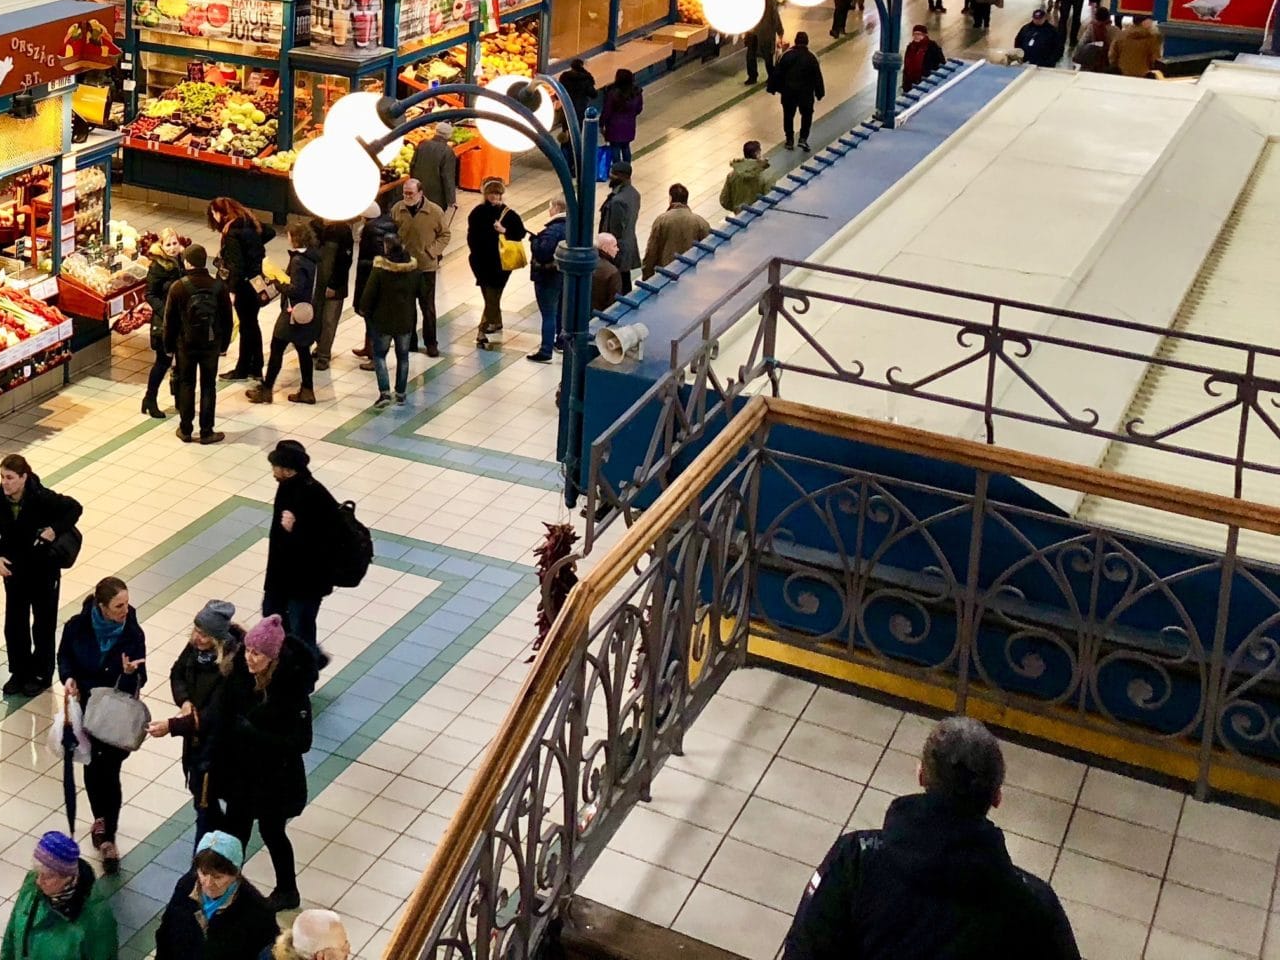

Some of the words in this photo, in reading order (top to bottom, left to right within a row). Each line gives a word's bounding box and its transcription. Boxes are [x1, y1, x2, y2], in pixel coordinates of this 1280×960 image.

[231, 7, 271, 27] FRUIT
[227, 22, 271, 43] JUICE
[11, 37, 55, 67] ORSZÁG
